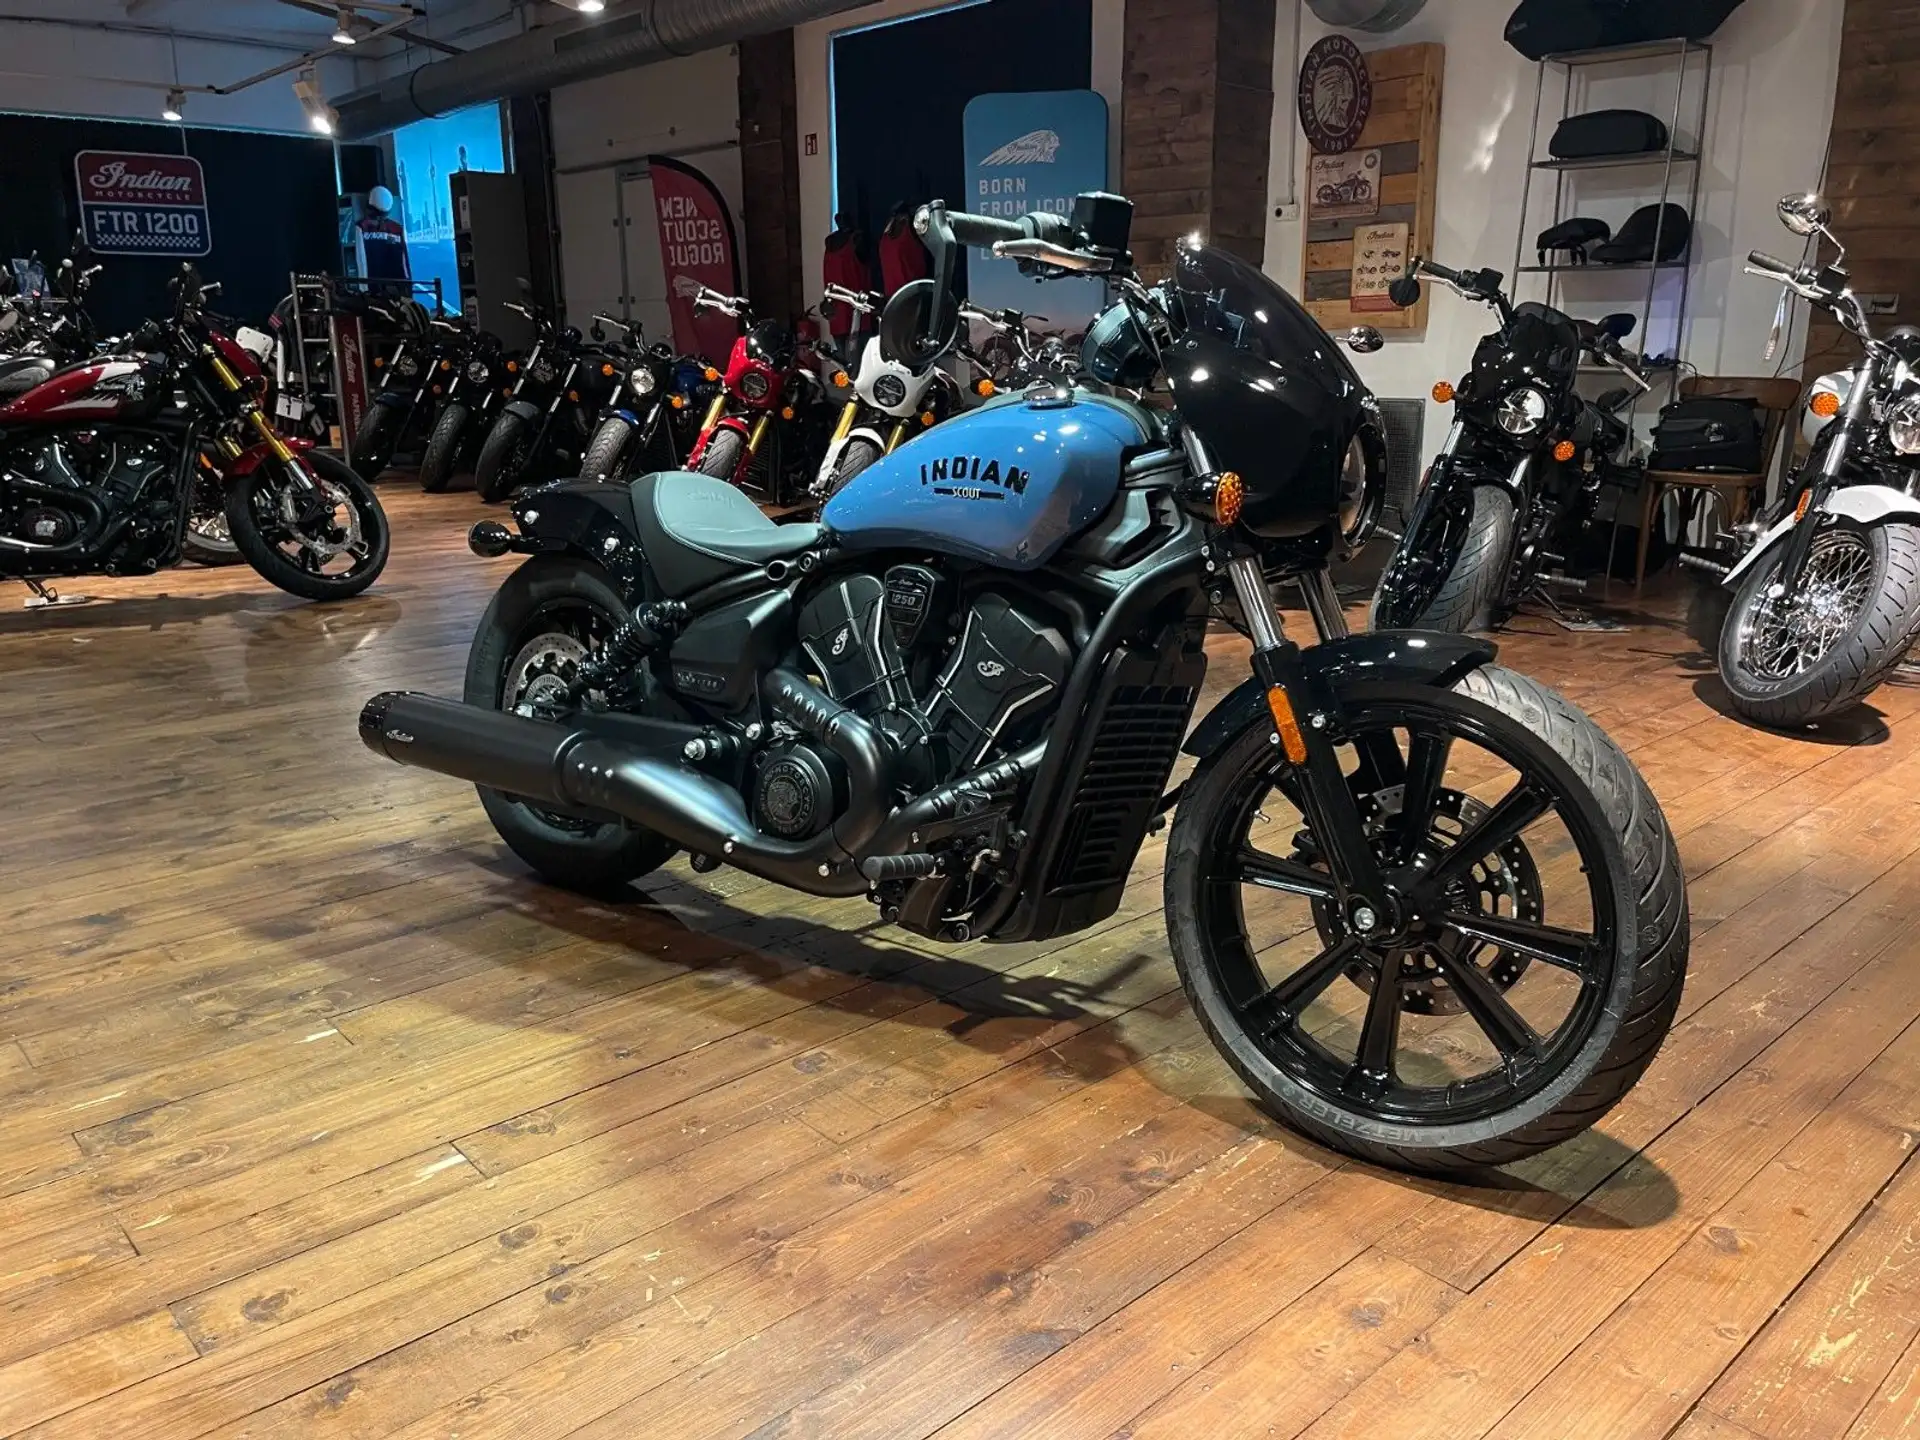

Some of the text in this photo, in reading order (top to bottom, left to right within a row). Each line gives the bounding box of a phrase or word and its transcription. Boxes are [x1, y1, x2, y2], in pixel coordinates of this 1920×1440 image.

[89, 162, 191, 191] Indian
[95, 191, 190, 200] MOTORCYCLE
[979, 178, 1026, 195] BORN
[980, 199, 1027, 217] FROM
[92, 210, 199, 235] FTR 1200
[920, 456, 1030, 495] INDIAN
[952, 486, 982, 499] SCOUT
[891, 593, 916, 606] 1250
[1299, 1098, 1423, 1142] METZELER
